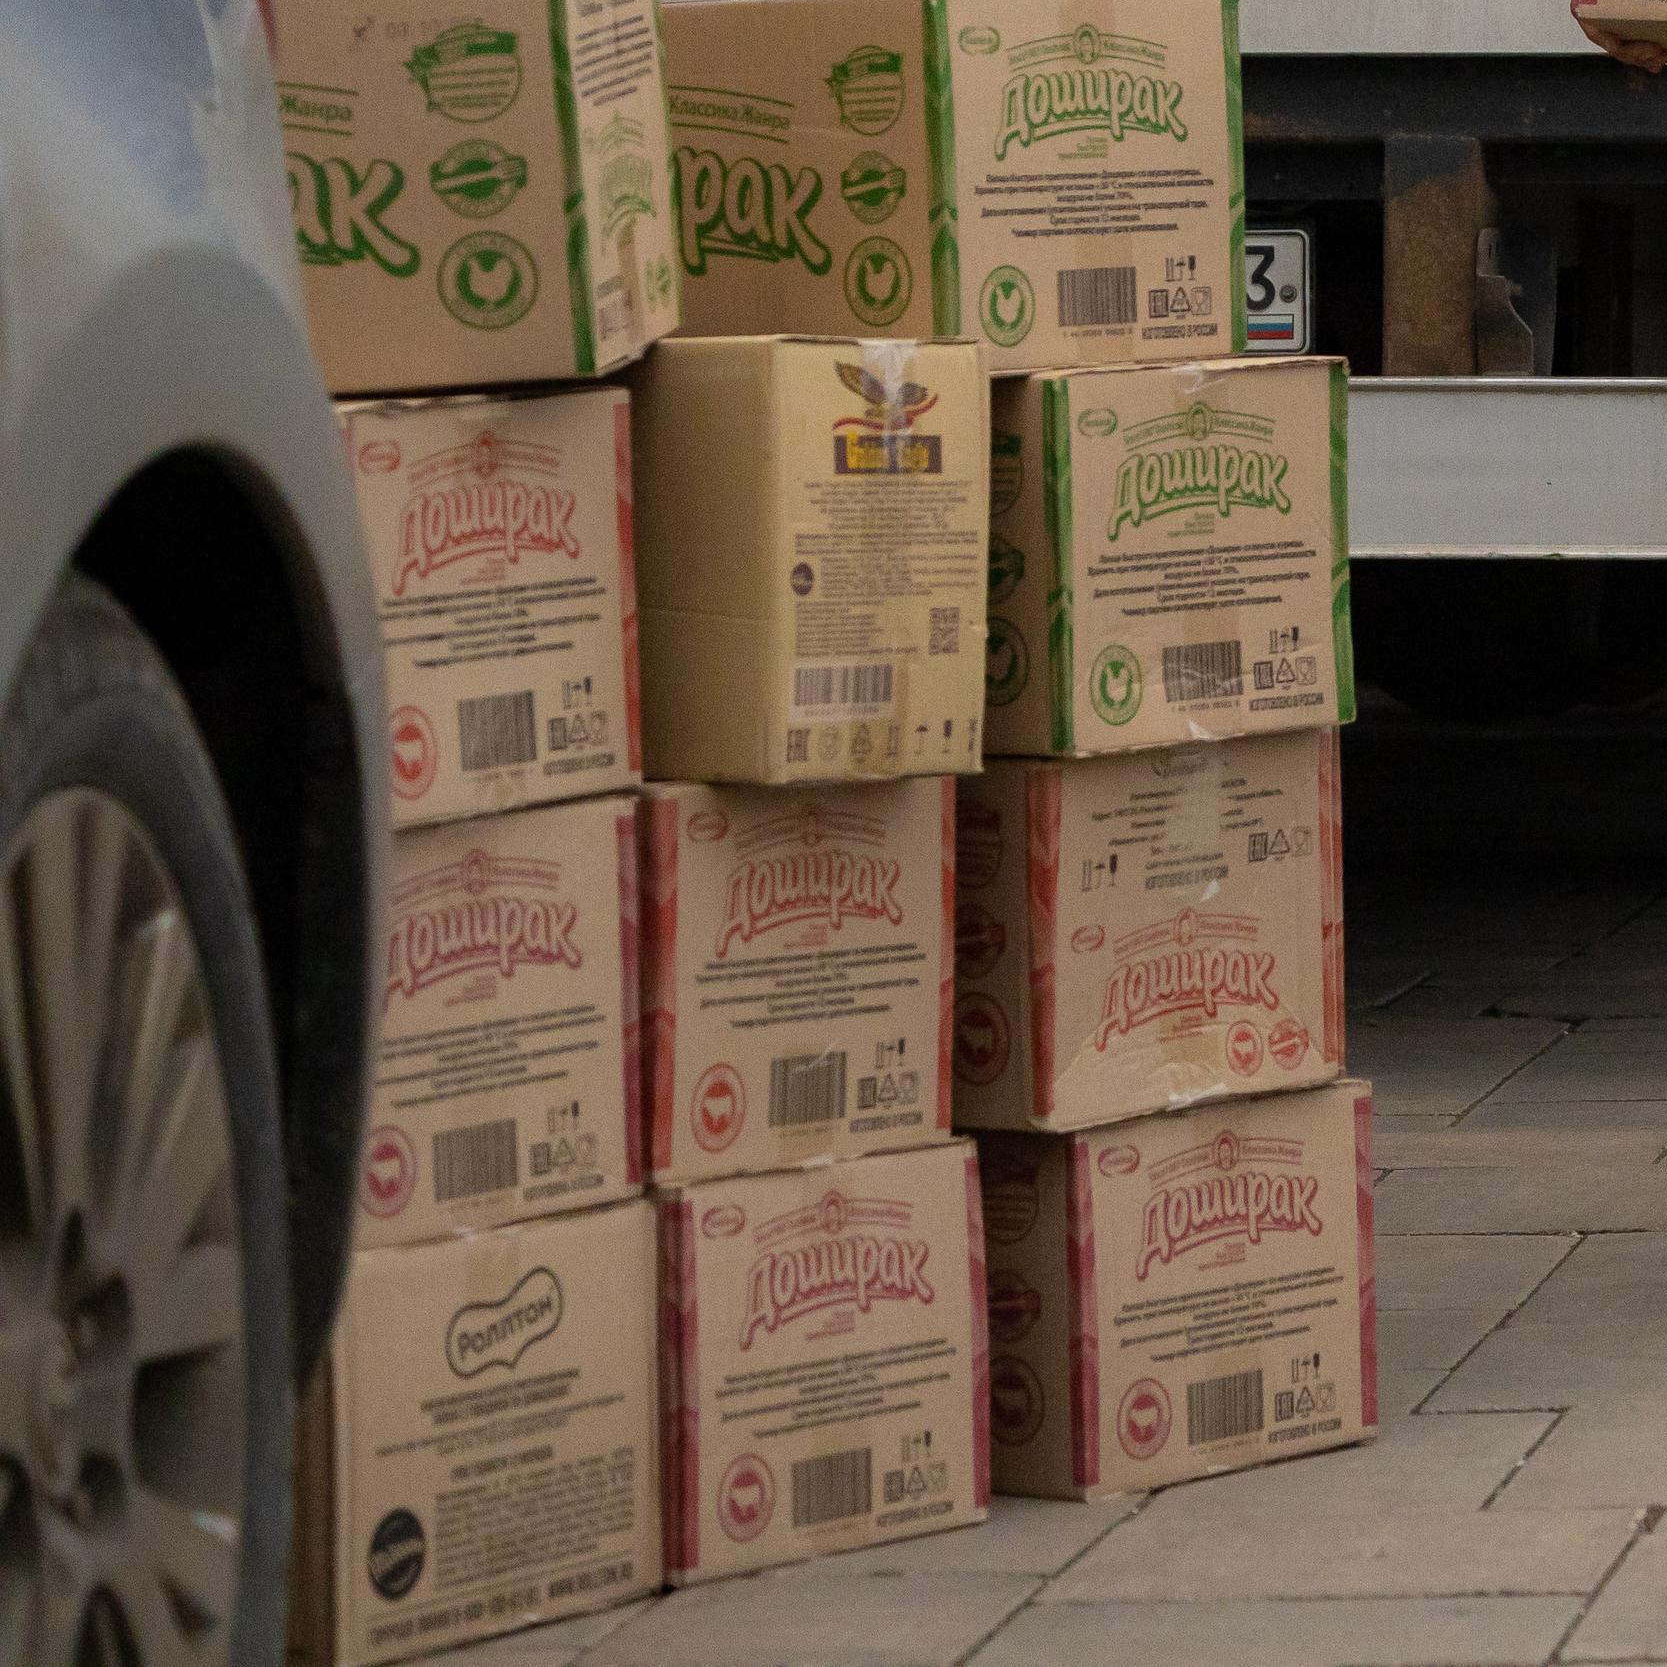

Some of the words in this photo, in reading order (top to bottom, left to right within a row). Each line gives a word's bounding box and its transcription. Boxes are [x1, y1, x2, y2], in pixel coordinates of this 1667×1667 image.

[994, 67, 1188, 162] Доширак
[394, 482, 579, 596] Доширак
[1108, 444, 1291, 542] Доширак
[715, 850, 903, 960] Доширак
[1095, 948, 1279, 1053] Доширак
[1136, 1172, 1322, 1282] Доширак
[739, 1235, 935, 1351] Доширак
